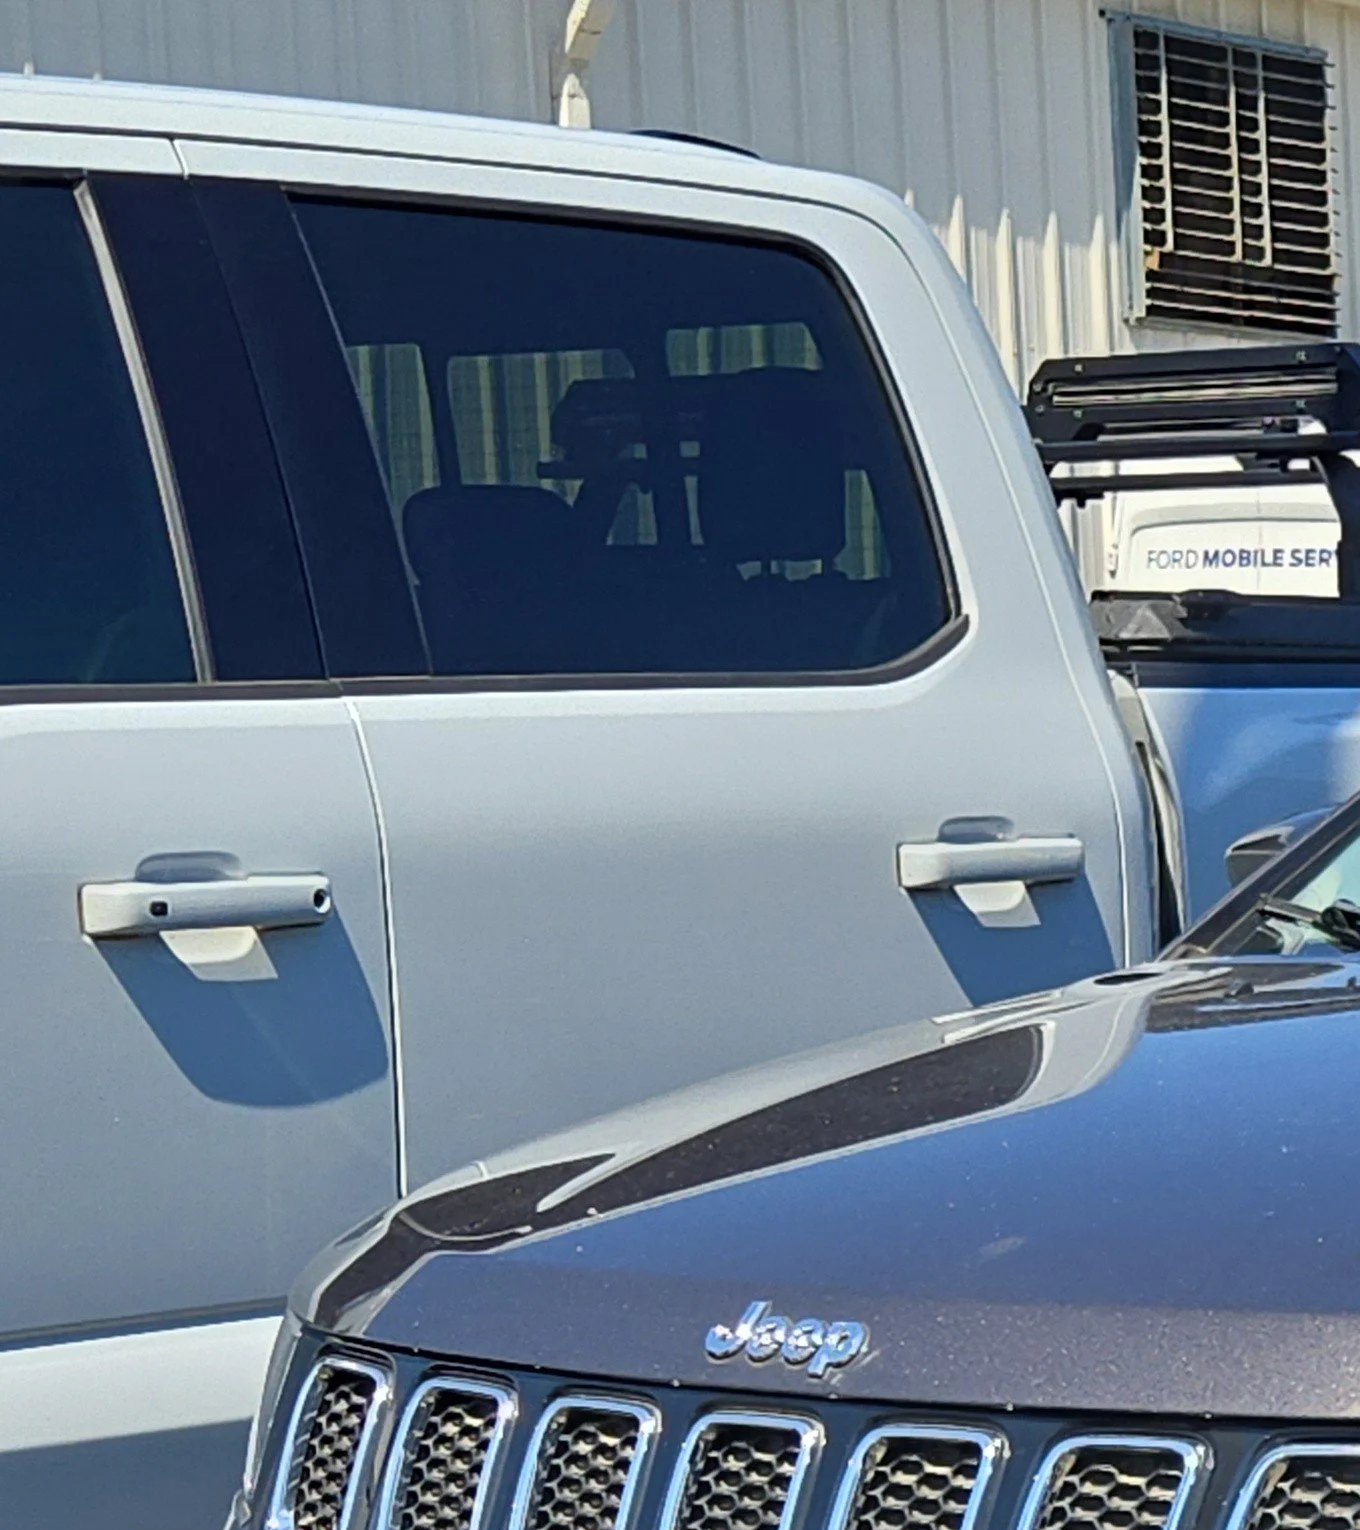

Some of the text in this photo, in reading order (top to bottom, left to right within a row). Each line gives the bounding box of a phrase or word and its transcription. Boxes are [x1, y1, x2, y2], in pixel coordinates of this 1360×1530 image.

[1146, 548, 1339, 569] FORD MOBILE SER
[705, 1300, 870, 1379] Jeep
